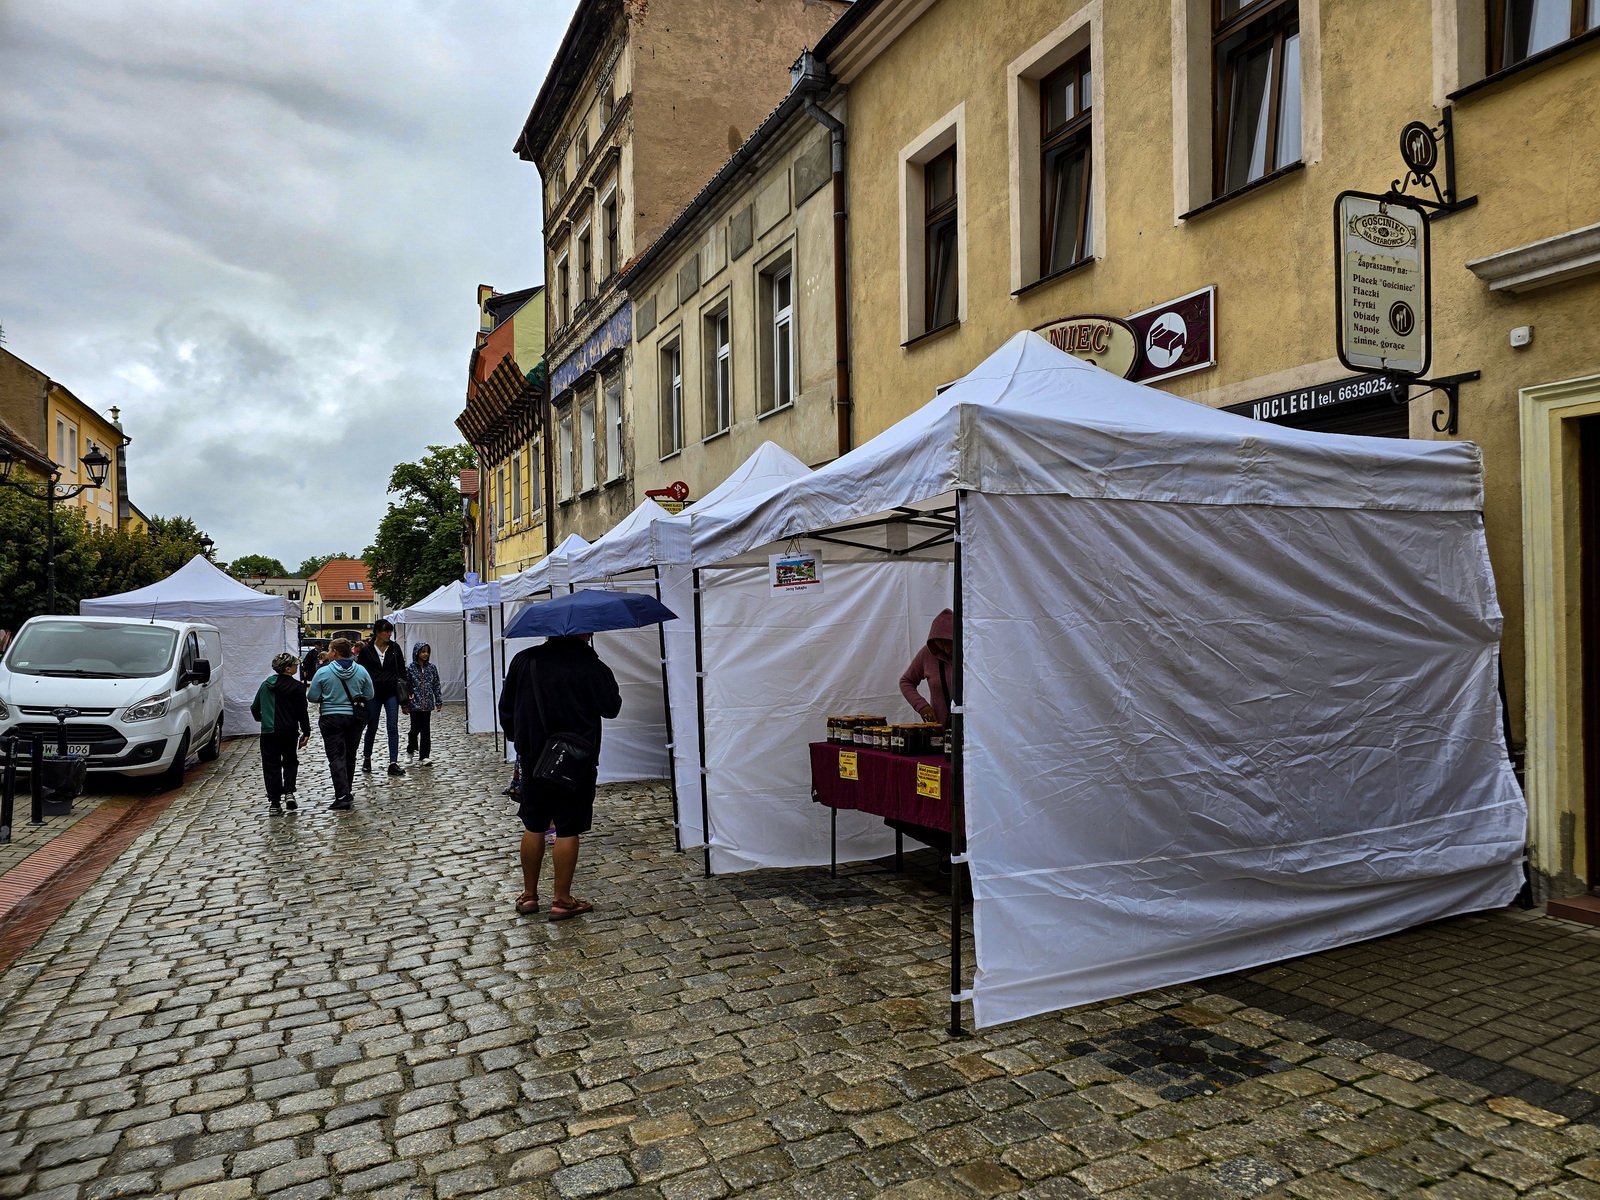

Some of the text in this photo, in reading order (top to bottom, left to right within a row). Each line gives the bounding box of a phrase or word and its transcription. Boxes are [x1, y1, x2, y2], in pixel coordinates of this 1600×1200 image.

[1361, 216, 1406, 236] GOŚCINIEC
[1363, 230, 1372, 240] NA
[1358, 258, 1408, 275] Zapraszamy na:
[1353, 273, 1378, 286] Placek
[1353, 286, 1380, 298] Flaczki
[1353, 298, 1376, 310] Frytki
[1353, 310, 1380, 323] Obiady
[1353, 323, 1380, 335] Napoje
[1353, 336, 1405, 351] zimne, gorące
[1253, 390, 1316, 421] NOCLEGI
[1318, 390, 1335, 406] tel.
